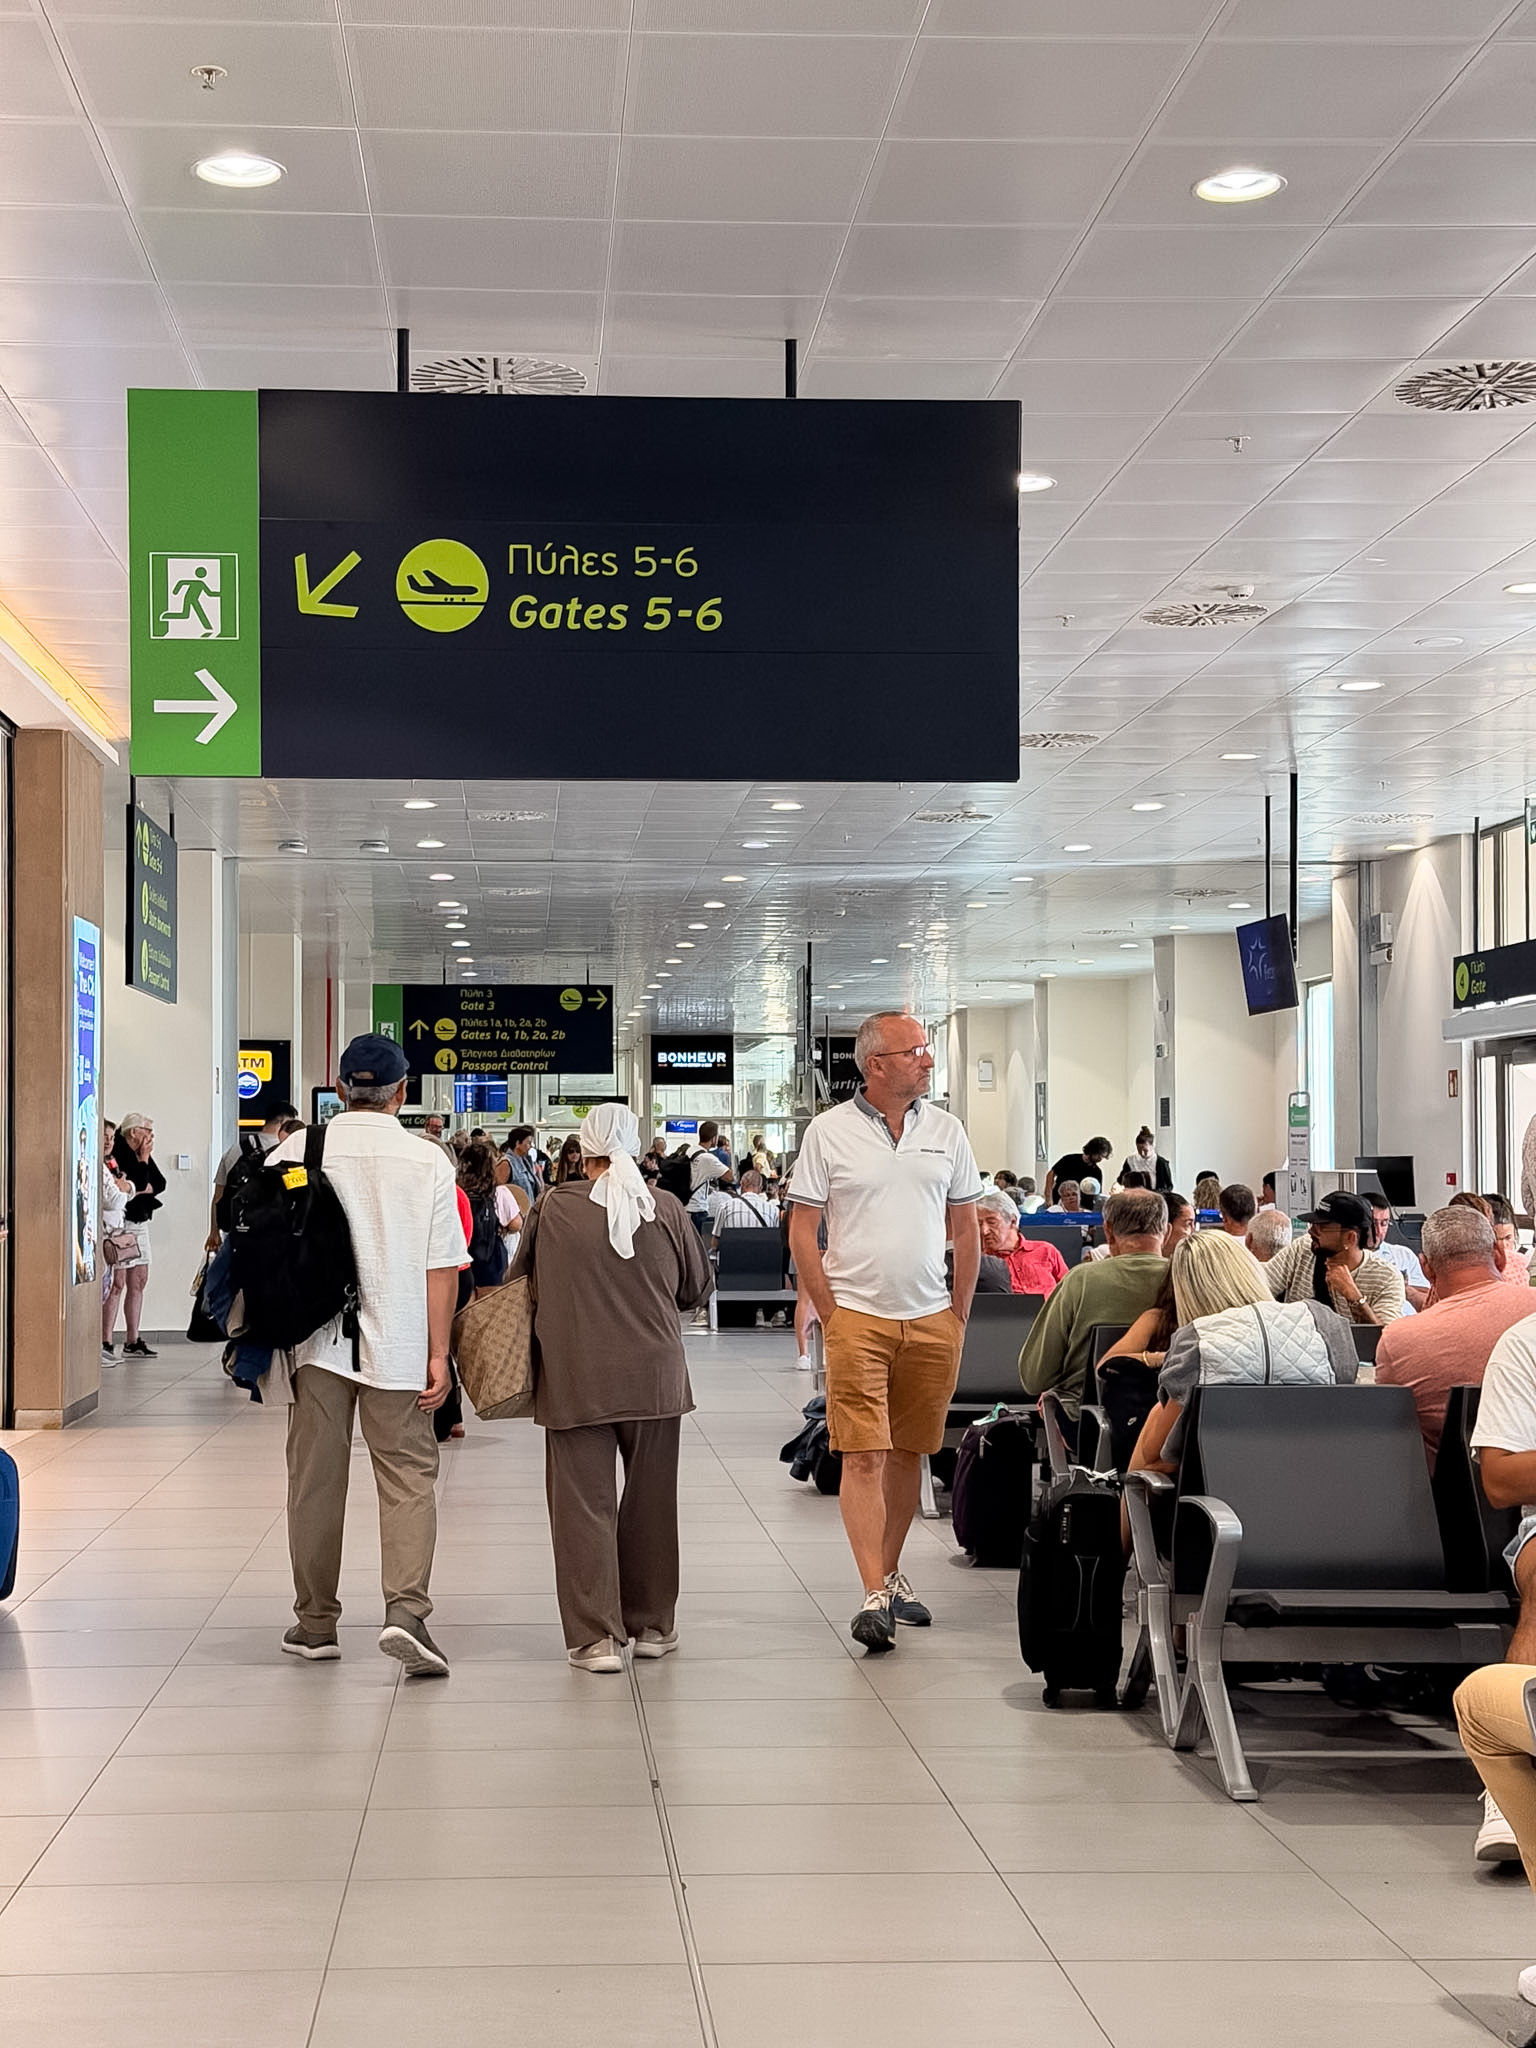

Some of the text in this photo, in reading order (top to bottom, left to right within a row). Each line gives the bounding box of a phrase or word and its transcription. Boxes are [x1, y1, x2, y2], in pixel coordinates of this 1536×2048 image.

[508, 542, 698, 578] Πύλες 5-6
[509, 594, 723, 632] Gates 5-6
[1470, 979, 1487, 995] Gate
[486, 989, 493, 998] 3
[460, 1001, 495, 1011] Gate 3
[460, 1030, 491, 1040] Gates
[551, 1030, 566, 1040] 2b
[657, 1052, 727, 1063] BONHEUR
[832, 1052, 855, 1060] BON
[238, 1057, 265, 1068] TM
[461, 1061, 549, 1072] Passport Control
